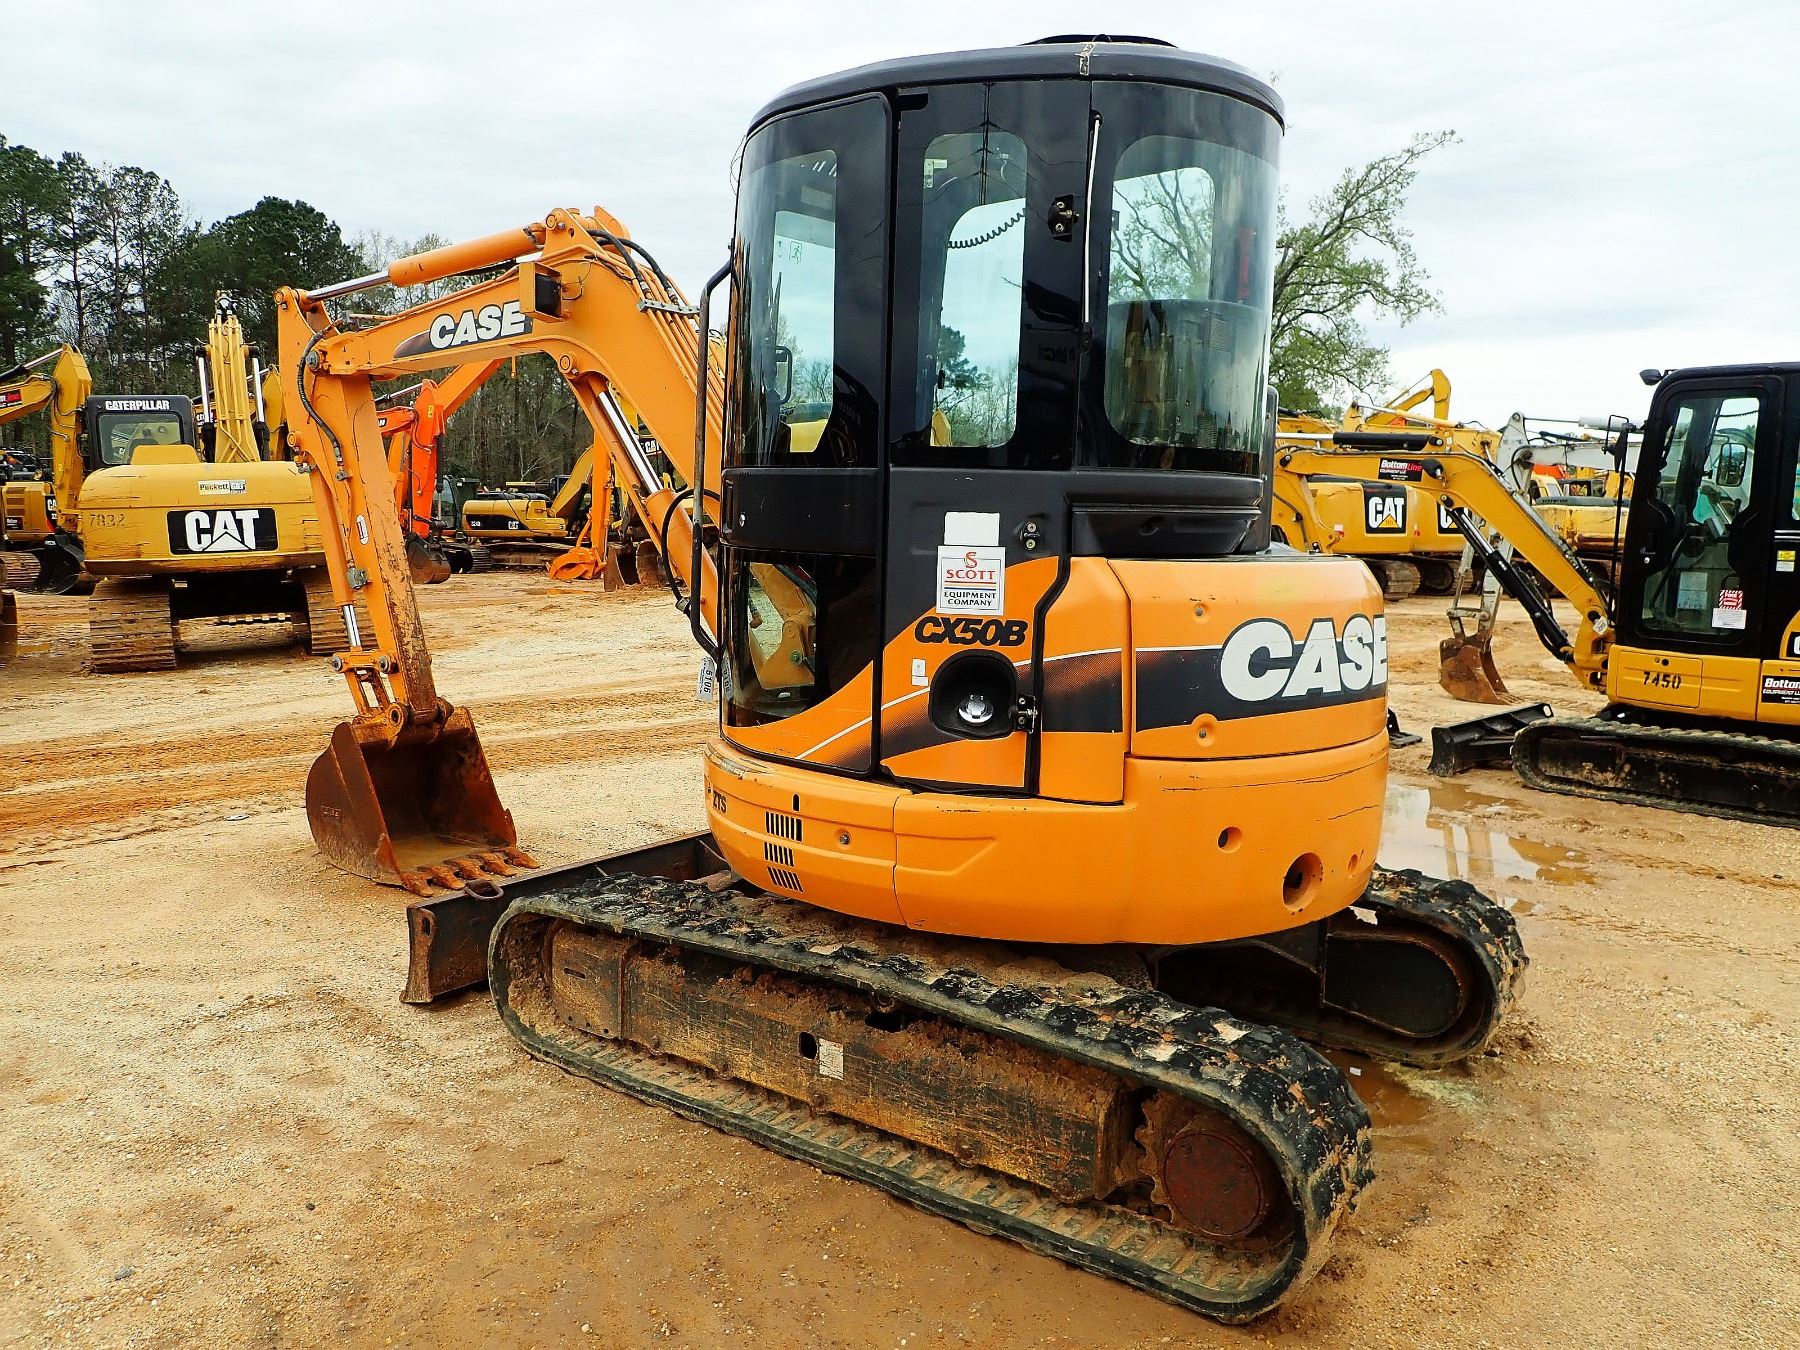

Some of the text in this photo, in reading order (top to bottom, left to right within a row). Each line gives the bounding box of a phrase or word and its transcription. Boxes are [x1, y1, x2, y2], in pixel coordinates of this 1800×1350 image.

[430, 301, 525, 349] CASE
[105, 400, 170, 411] CATERPILLAR
[47, 499, 57, 511] CA
[1368, 496, 1404, 529] CAT
[184, 510, 260, 552] CAT
[946, 569, 996, 580] SCOTT
[944, 591, 997, 599] EQUIPMENT
[947, 598, 992, 607] COMPANY
[914, 615, 1029, 647] CX50B
[1220, 614, 1388, 702] CASE
[703, 669, 713, 694] 5106
[1643, 671, 1682, 690] 7450
